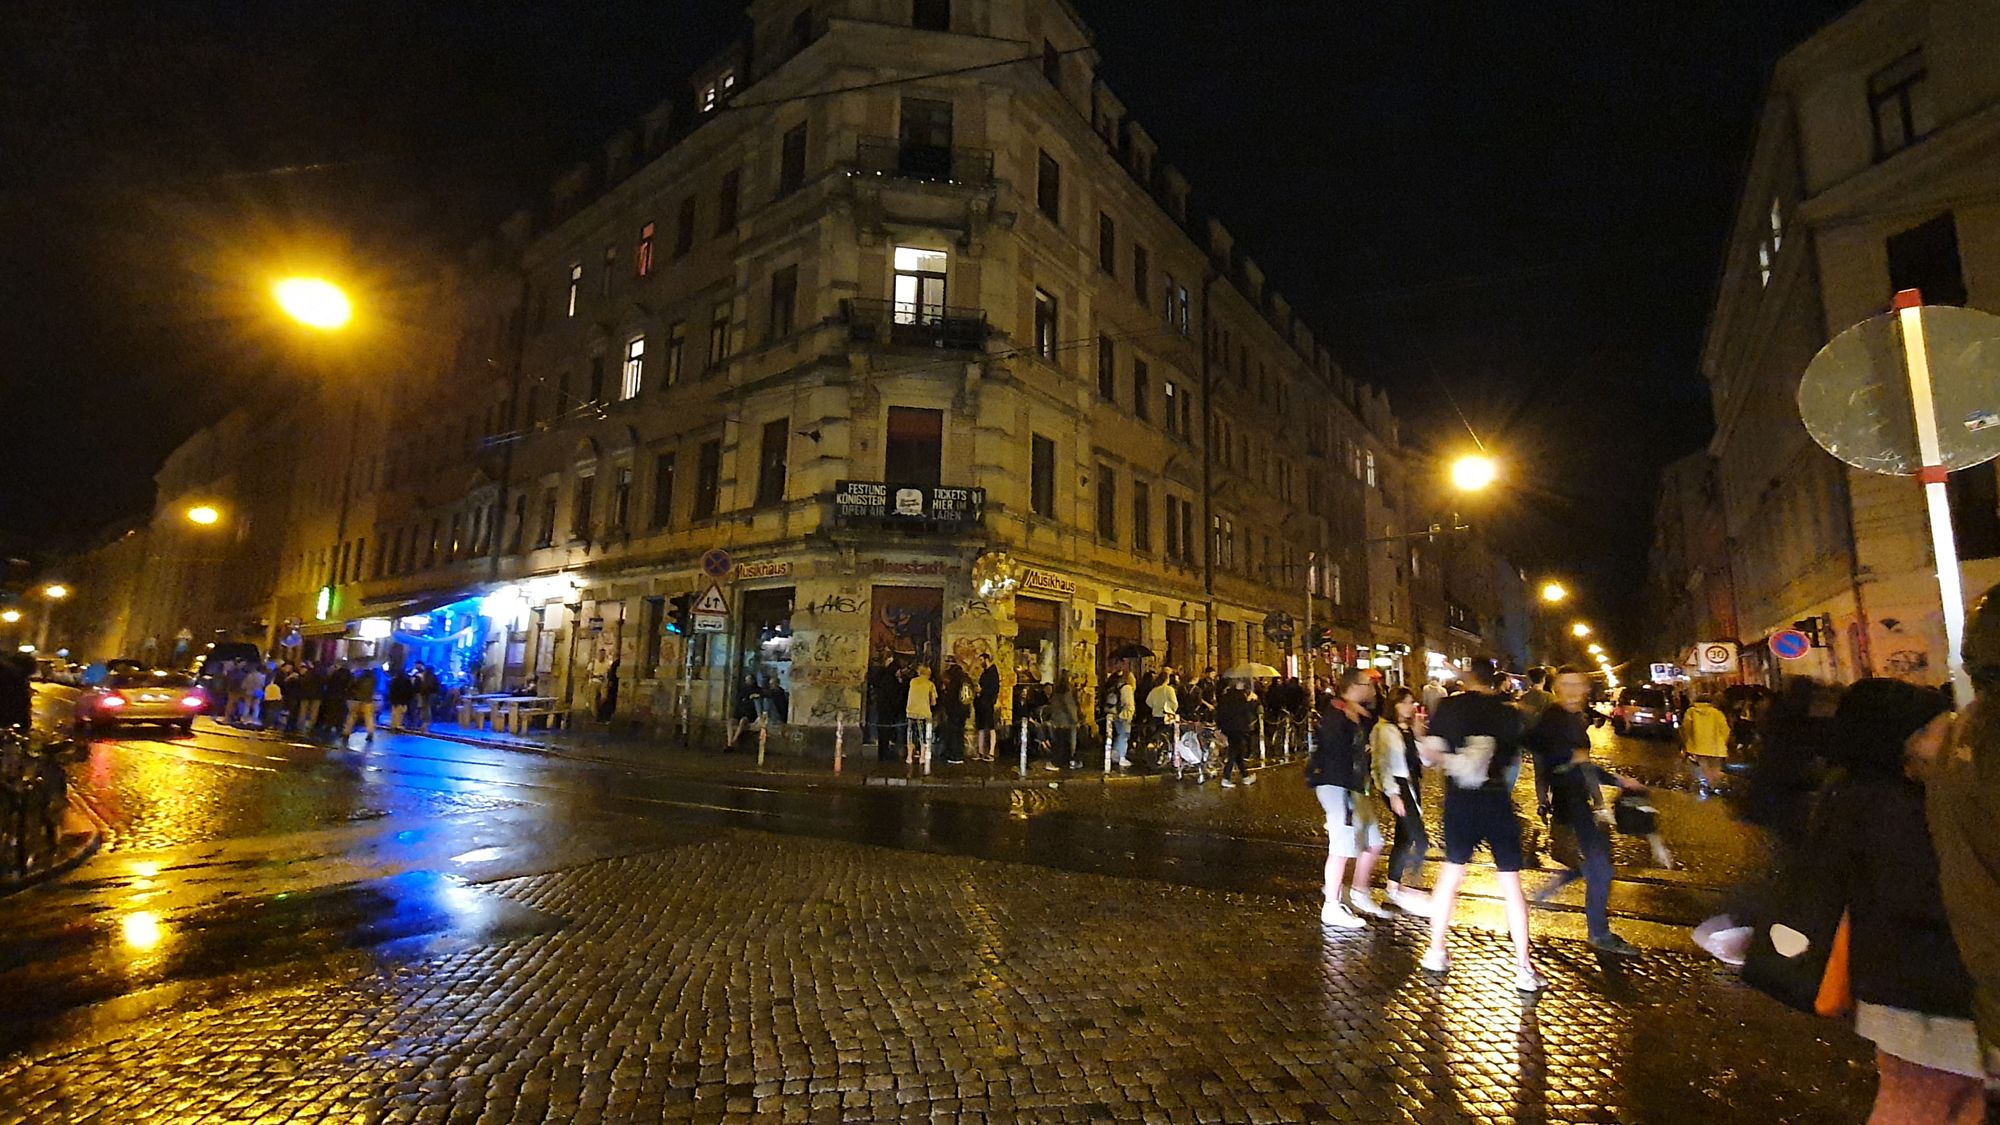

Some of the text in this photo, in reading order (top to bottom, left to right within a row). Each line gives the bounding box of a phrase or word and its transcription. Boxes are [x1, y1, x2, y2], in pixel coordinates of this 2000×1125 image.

[848, 483, 887, 496] FESTUNG
[933, 488, 968, 501] TICKETS
[932, 499, 953, 510] HIER
[842, 505, 886, 517] OPEN AIR
[1029, 571, 1076, 593] Musikhaus
[1709, 650, 1725, 660] 30
